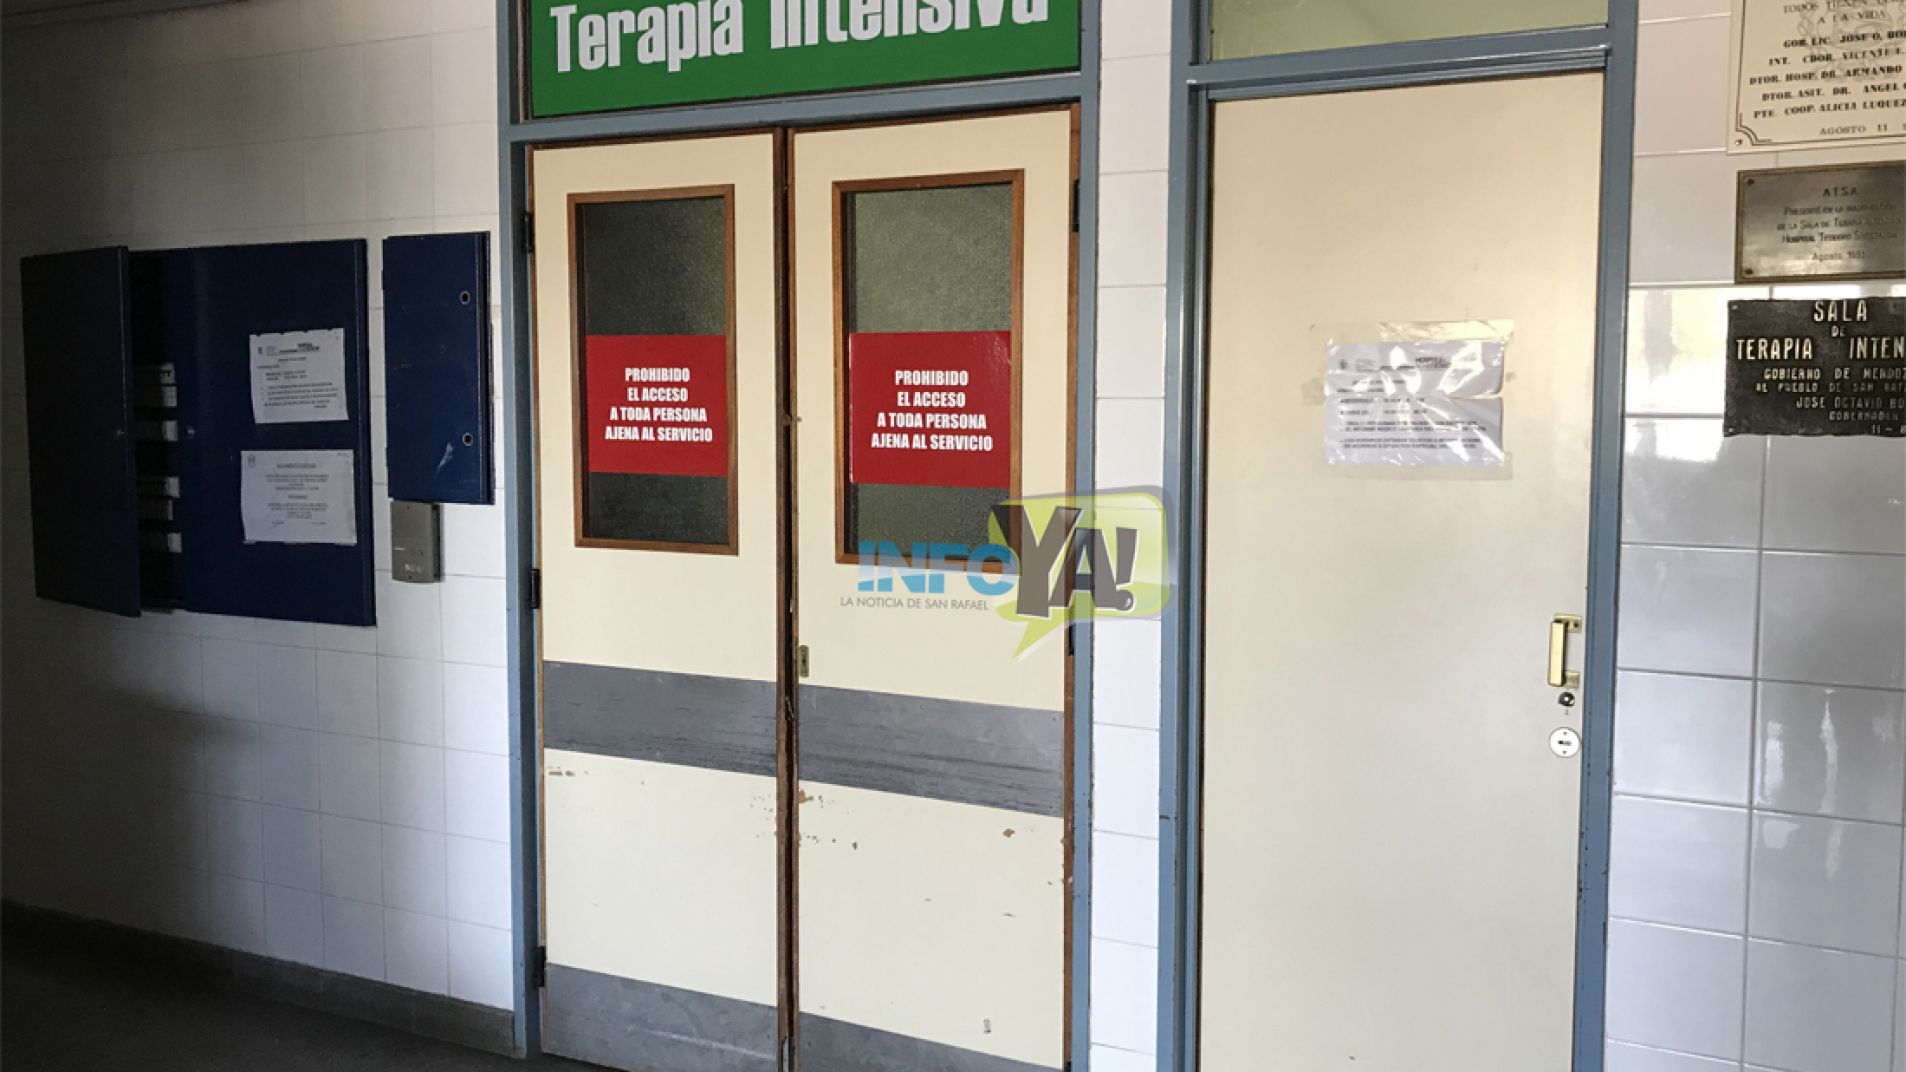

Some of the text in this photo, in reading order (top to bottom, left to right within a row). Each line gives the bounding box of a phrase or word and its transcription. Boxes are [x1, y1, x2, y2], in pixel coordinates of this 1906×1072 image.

[549, 0, 744, 72] Terapia
[1845, 65, 1903, 77] ARMANDO
[1832, 86, 1851, 96] DR.
[1863, 82, 1900, 93] ANGEL
[1819, 101, 1857, 112] ALICIA
[1819, 125, 1867, 136] AGOSTO
[1813, 299, 1868, 322] SALA
[1830, 325, 1846, 338] DE
[1736, 336, 1905, 360] TERAPIA INTEN
[625, 367, 690, 382] PROHIBIDO
[895, 370, 969, 386] PROHIBIDO
[1763, 367, 1821, 380] GOBIERNO
[1834, 367, 1850, 379] DE
[627, 386, 688, 402] EL ACCESO
[1828, 382, 1841, 393] DE
[897, 391, 966, 408] EL ACCESO
[1796, 396, 1826, 409] JOSE
[1834, 396, 1882, 409] OCTAVIO
[610, 406, 708, 422] A TODA PERSONA
[877, 412, 987, 429] A TODA PERSONA
[605, 426, 713, 442] AJENA AL SERVICIO
[871, 433, 993, 452] AJENA AL SERVICIO
